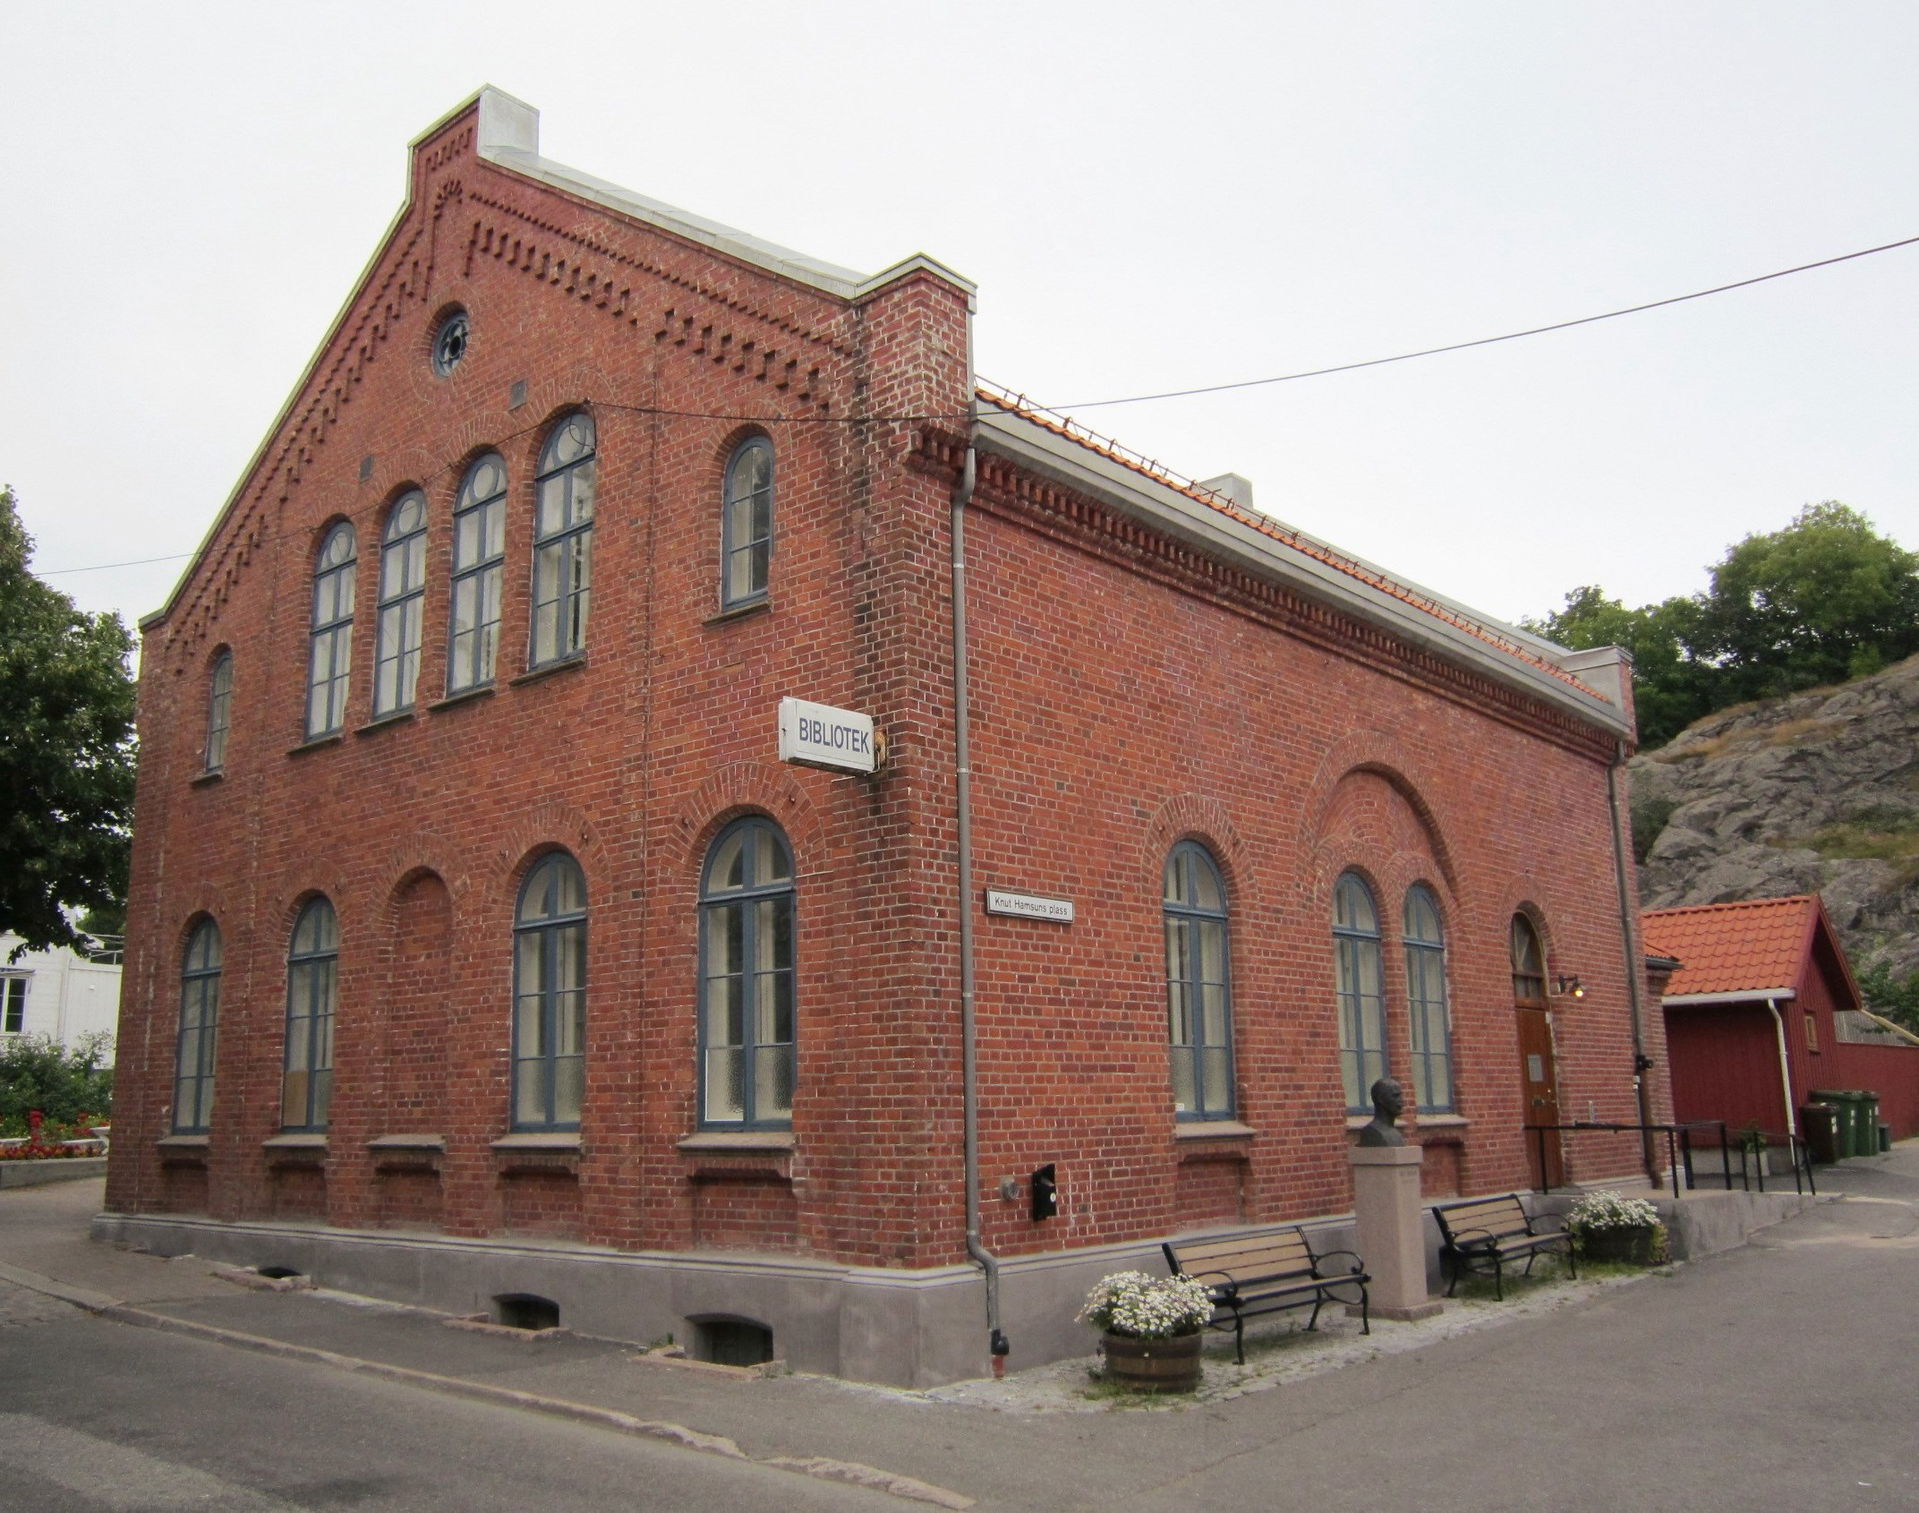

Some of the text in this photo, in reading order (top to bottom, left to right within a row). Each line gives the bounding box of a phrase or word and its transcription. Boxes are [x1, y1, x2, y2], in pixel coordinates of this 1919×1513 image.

[798, 717, 870, 754] BIBLIOTEK
[994, 896, 1068, 916] Knut Hamsuns plass
